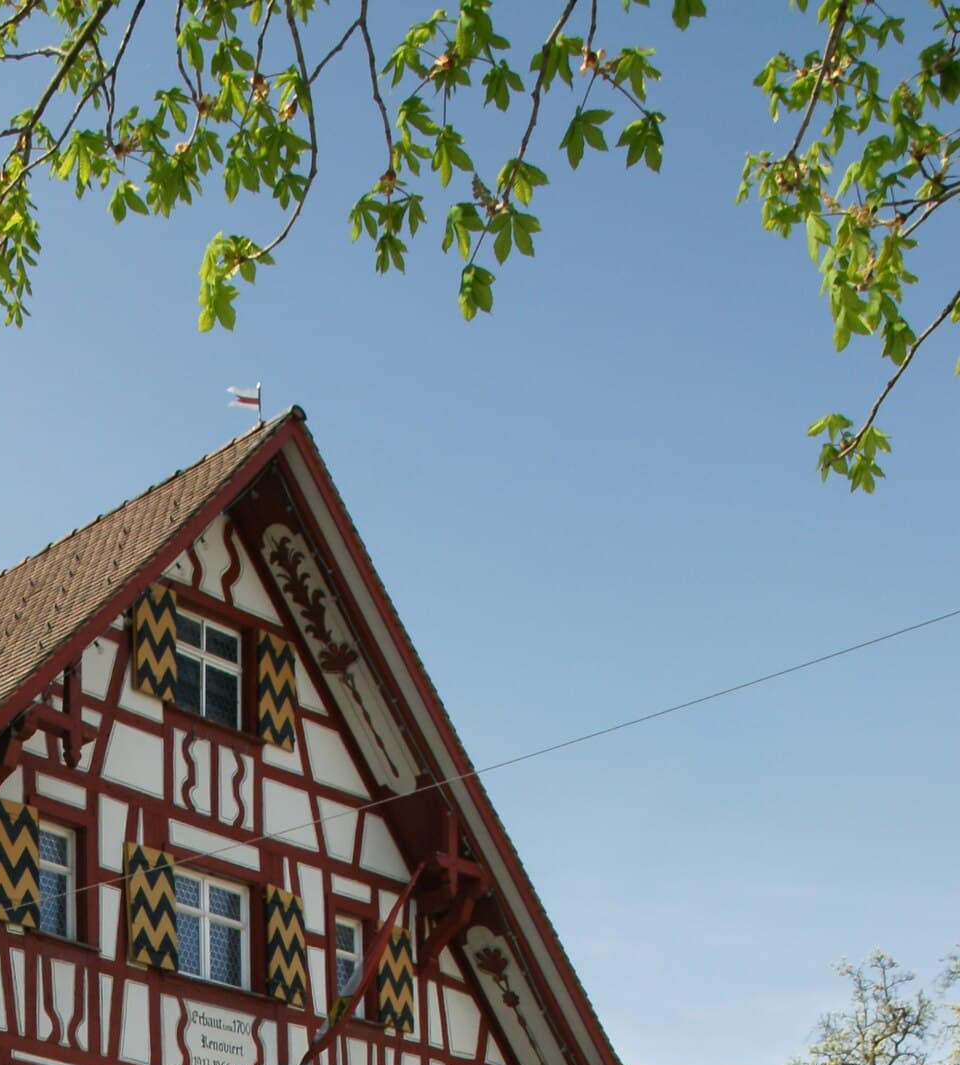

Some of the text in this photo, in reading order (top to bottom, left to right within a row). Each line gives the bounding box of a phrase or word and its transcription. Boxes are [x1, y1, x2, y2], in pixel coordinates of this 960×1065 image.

[191, 1010, 222, 1030] Erbaut
[232, 1019, 251, 1037] 1700
[200, 1033, 244, 1057] Renoviert
